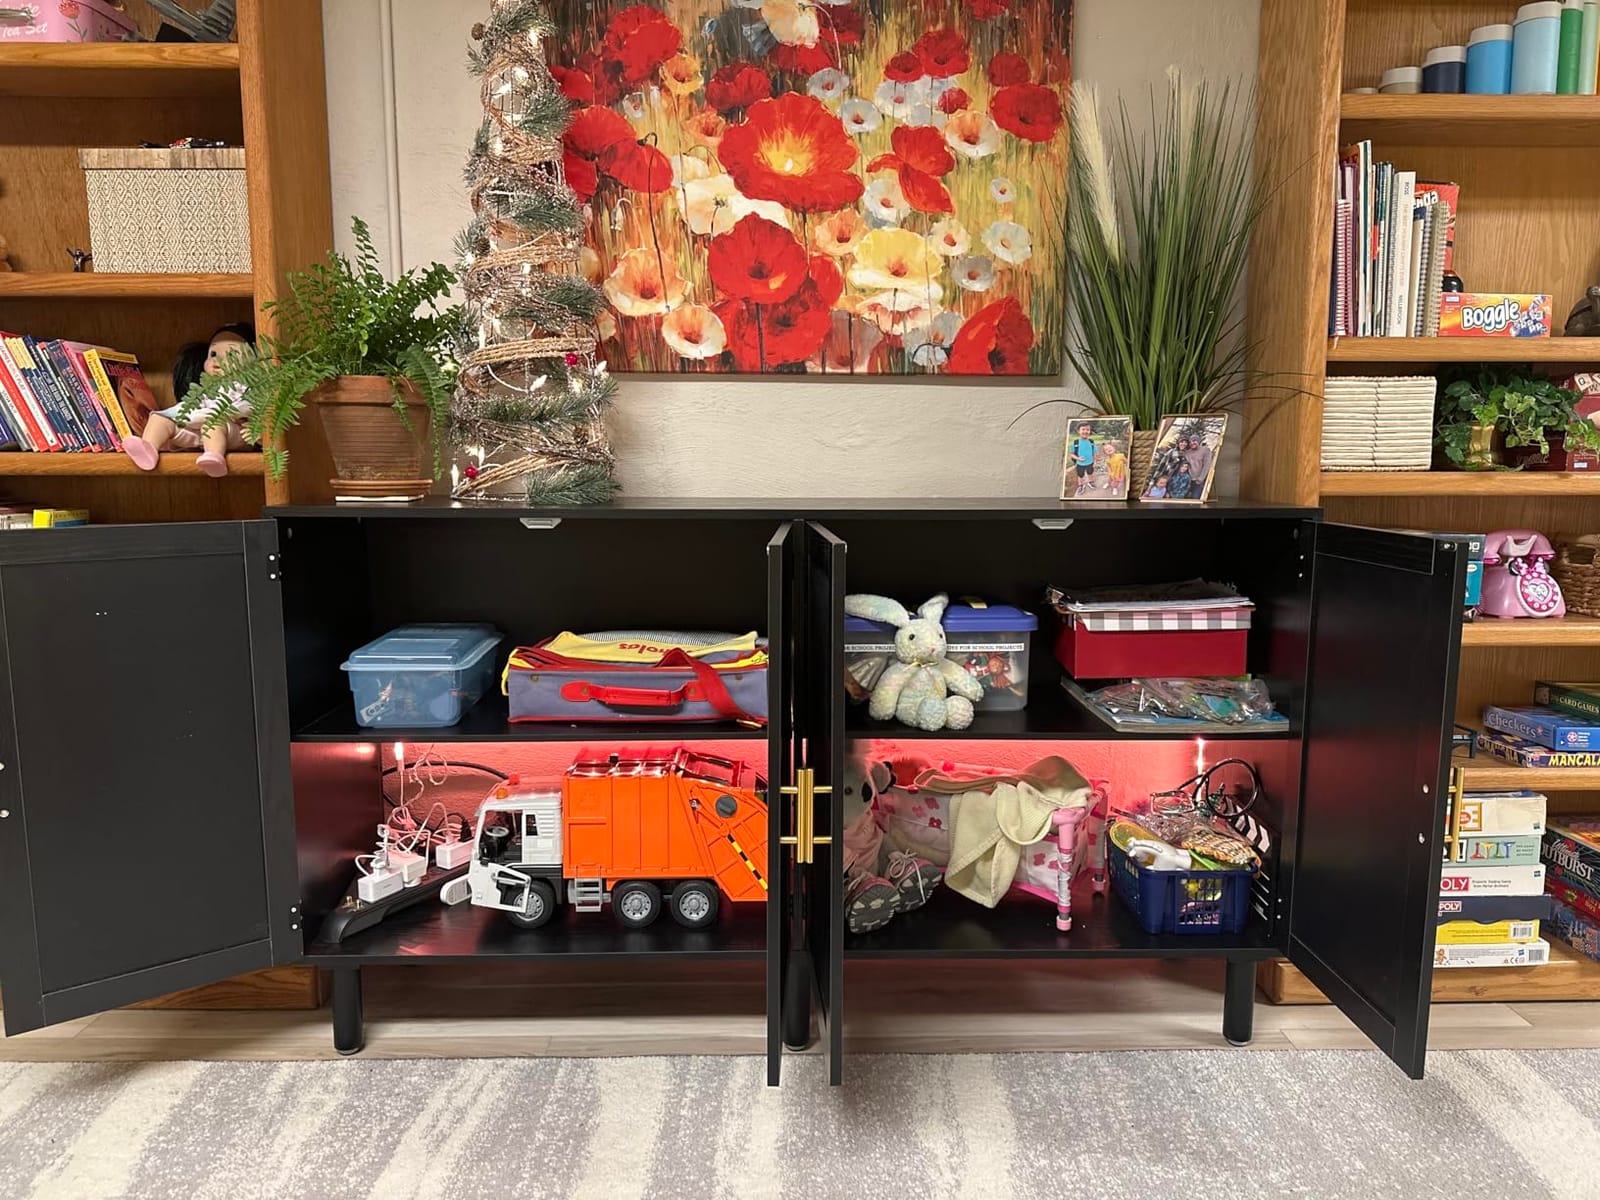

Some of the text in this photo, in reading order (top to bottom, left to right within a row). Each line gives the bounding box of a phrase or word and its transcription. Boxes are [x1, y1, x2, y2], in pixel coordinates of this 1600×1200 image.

[3, 22, 48, 38] Tea Set
[1462, 298, 1520, 331] Boggle
[1559, 696, 1577, 708] CARD
[1577, 701, 1600, 714] GAMES
[1487, 713, 1537, 738] Checkers
[1440, 878, 1468, 891] OLY
[1440, 903, 1460, 911] POLY
